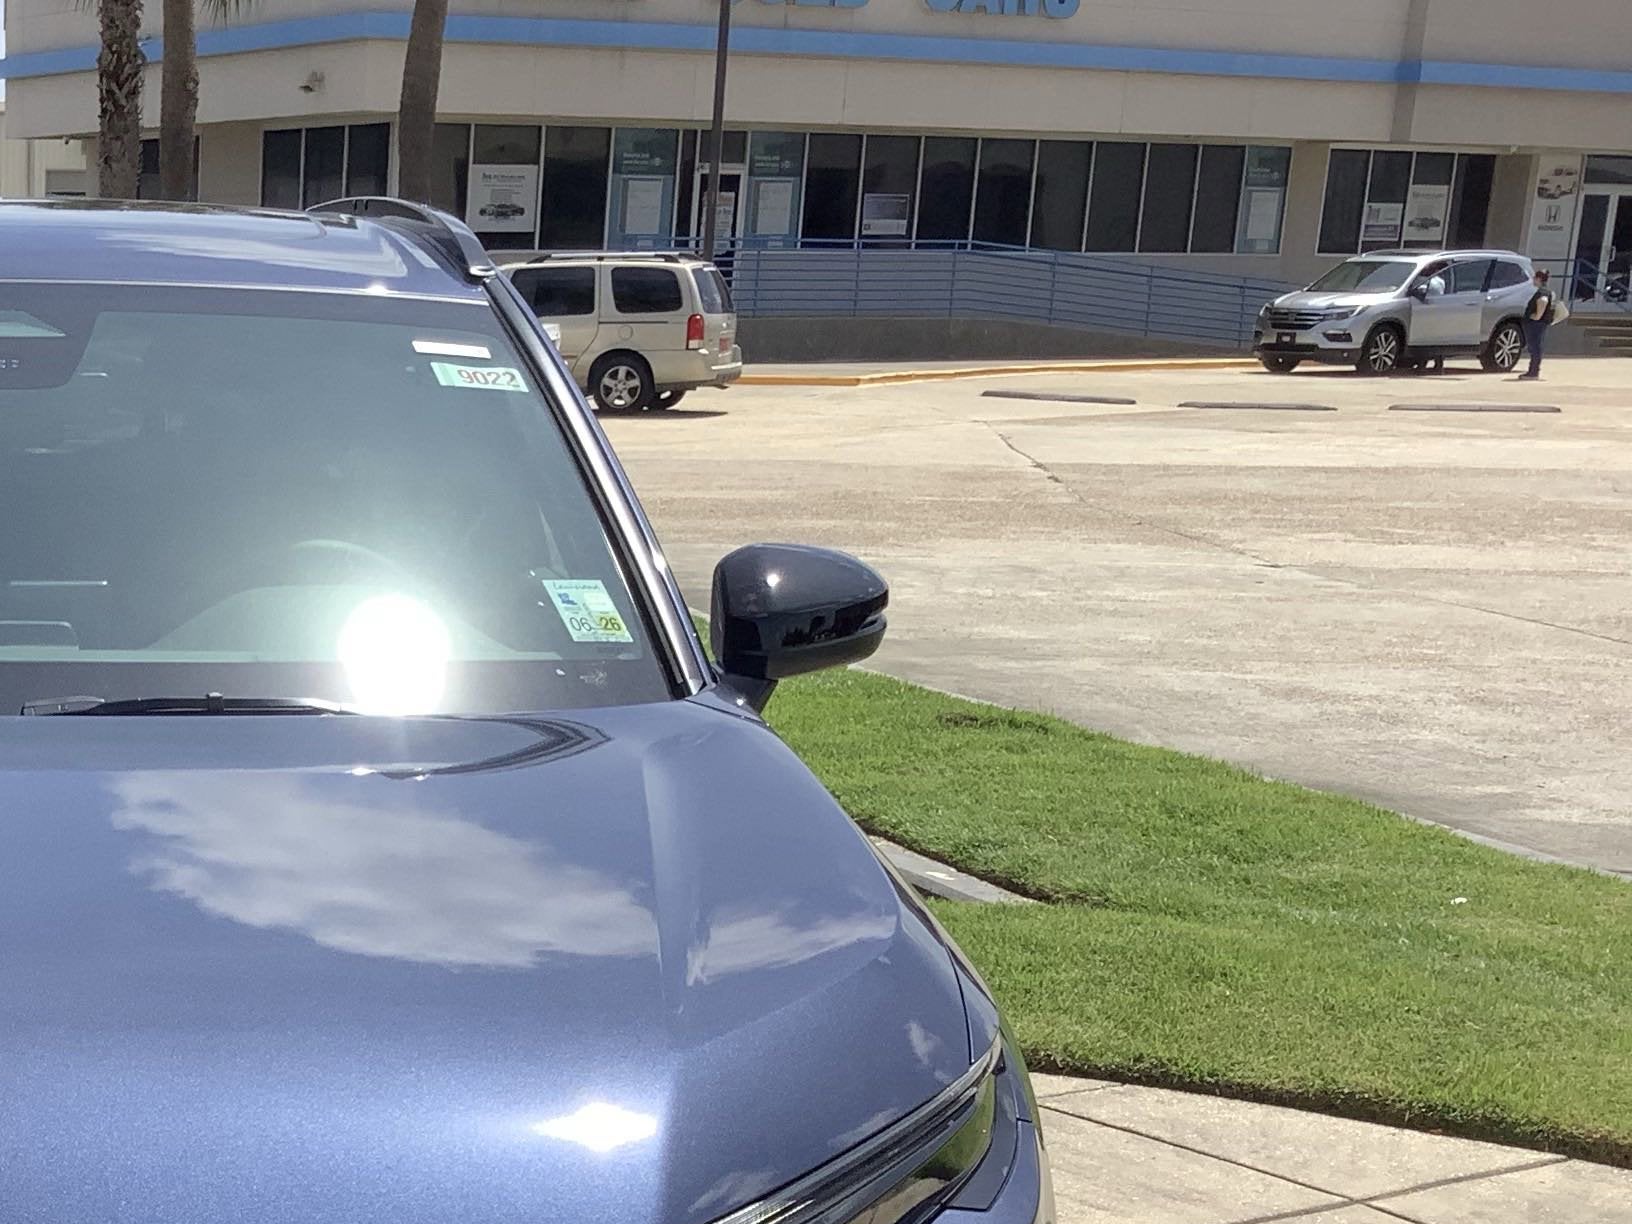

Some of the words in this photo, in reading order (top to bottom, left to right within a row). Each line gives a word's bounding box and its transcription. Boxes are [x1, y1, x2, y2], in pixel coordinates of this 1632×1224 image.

[457, 369, 521, 387] 9022
[569, 616, 592, 632] 06
[599, 616, 622, 632] 26
